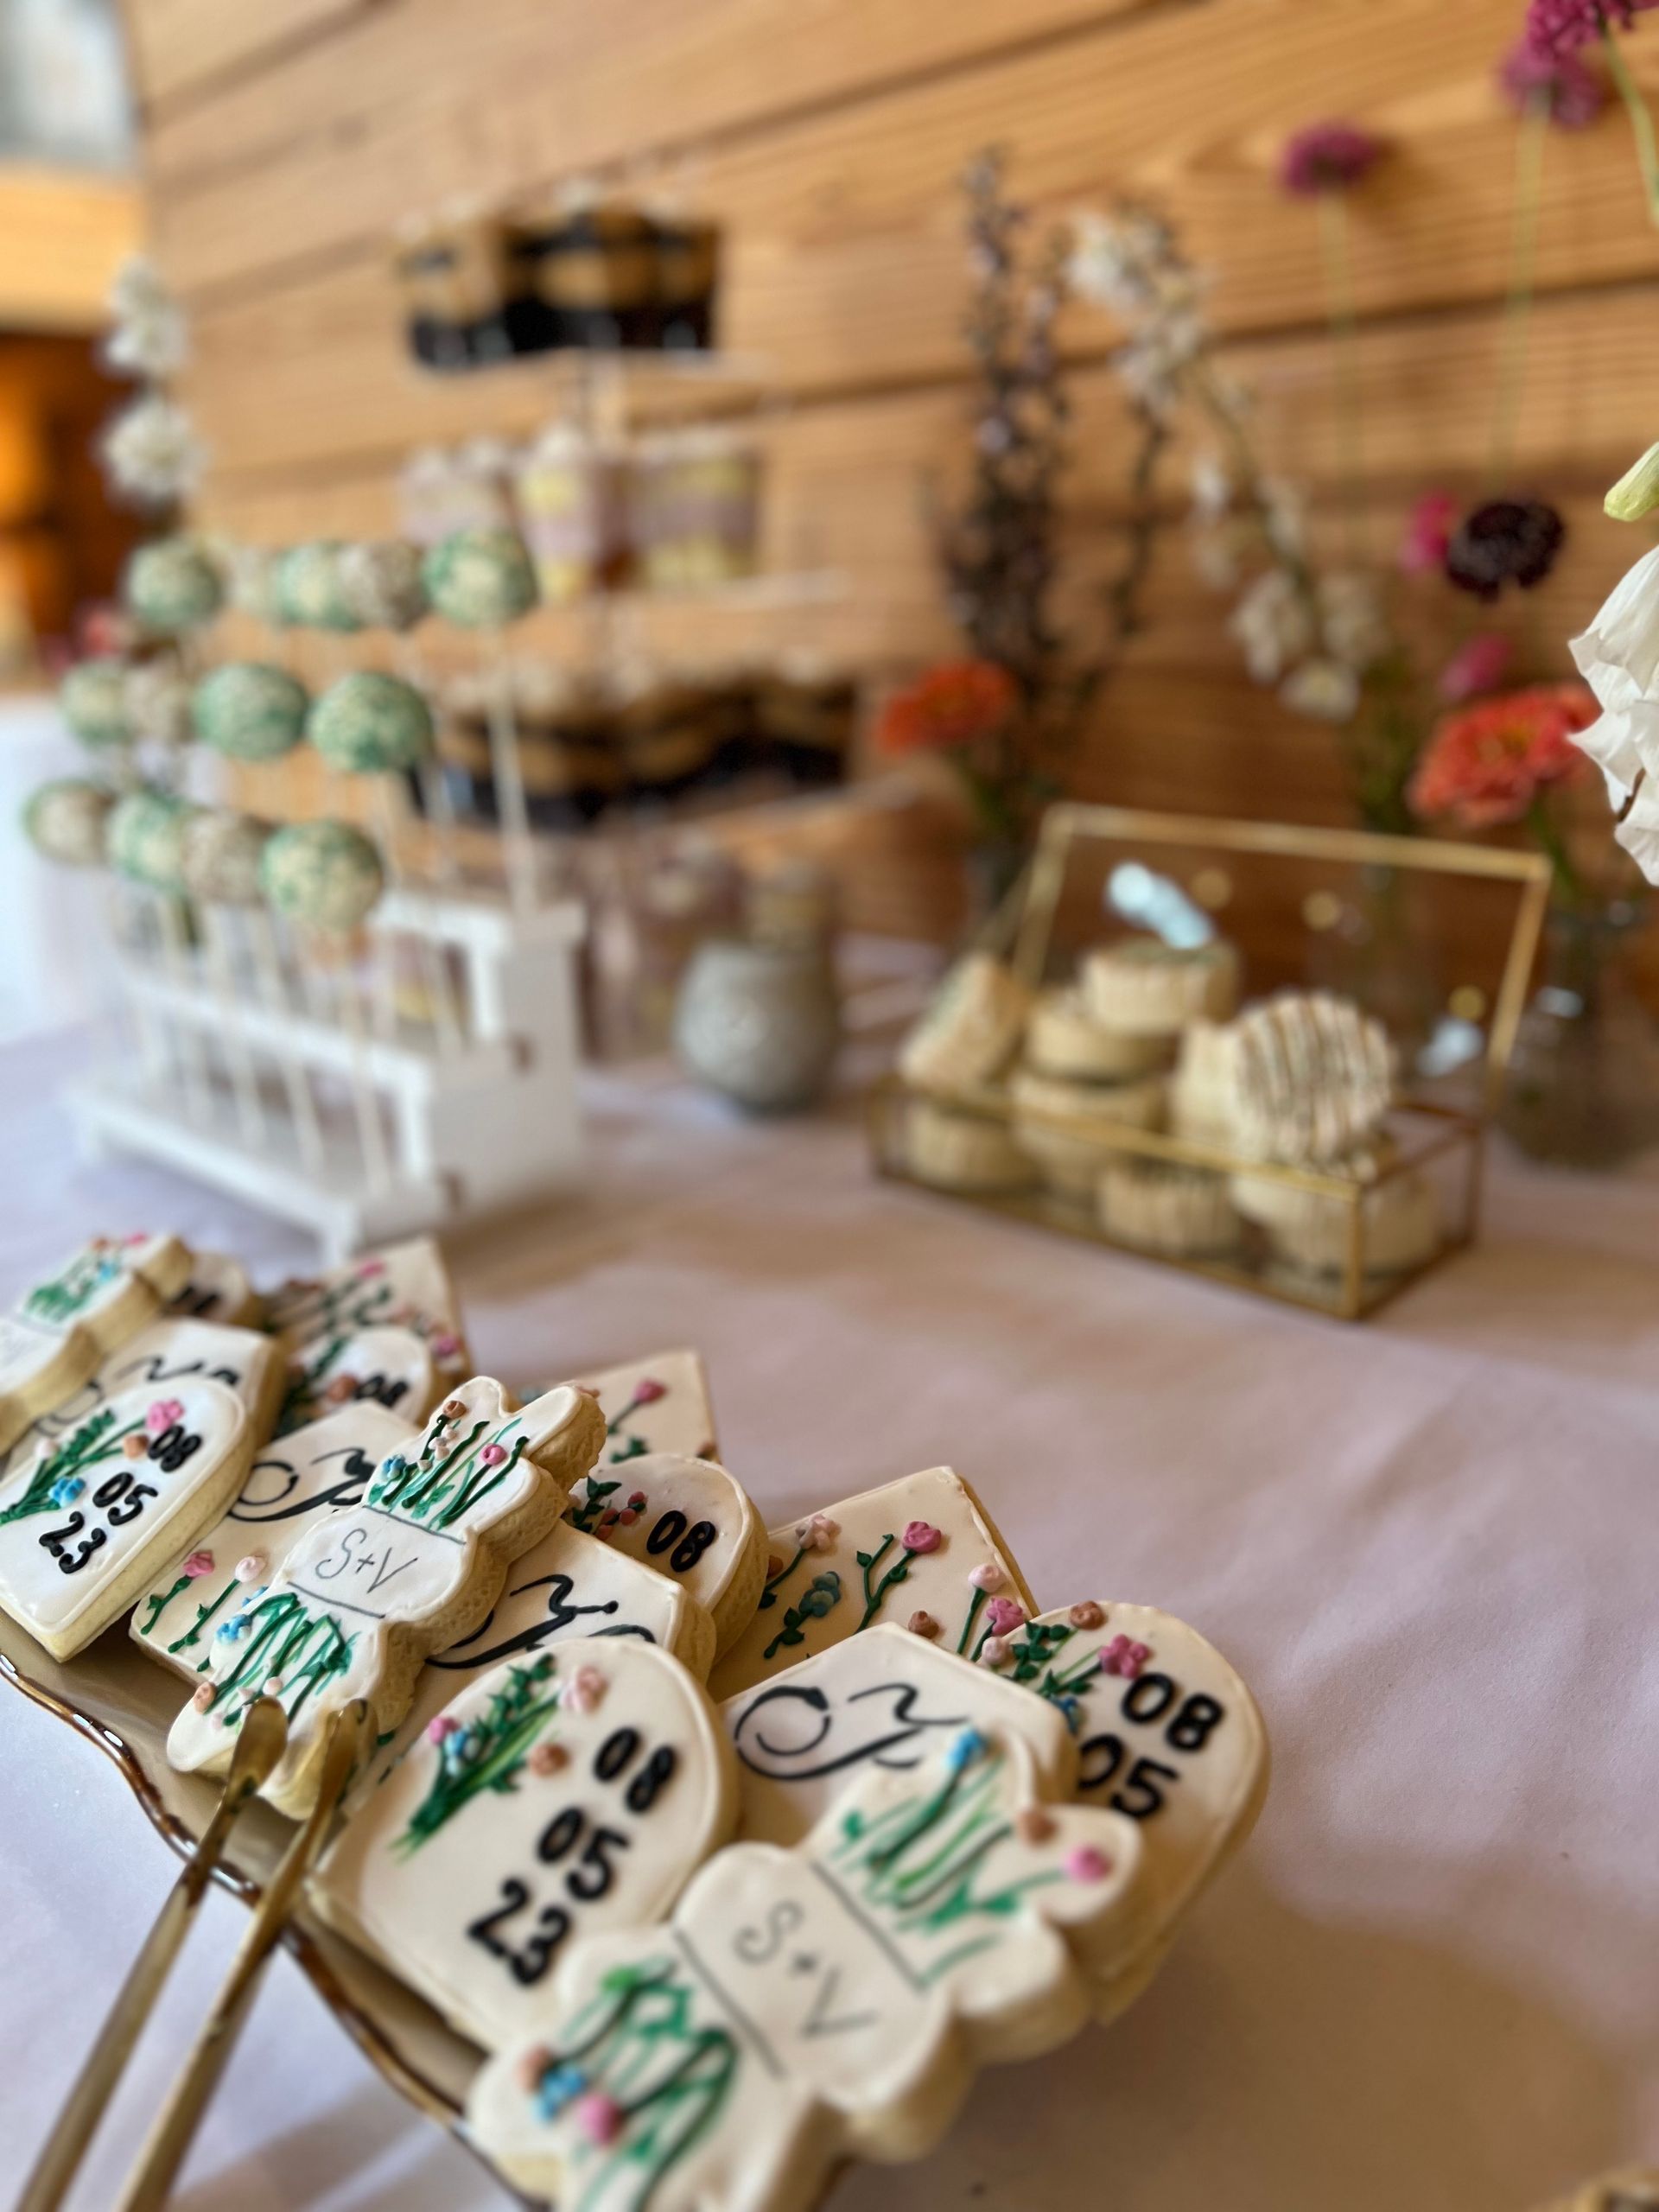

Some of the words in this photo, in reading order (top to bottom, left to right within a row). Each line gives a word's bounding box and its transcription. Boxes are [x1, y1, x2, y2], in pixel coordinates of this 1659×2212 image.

[148, 1426, 202, 1472] 08
[92, 1471, 158, 1526] 05
[39, 1511, 106, 1574] 23
[646, 1510, 716, 1573] 08
[1121, 1673, 1224, 1753] 08
[594, 1727, 676, 1814] 08
[1077, 1733, 1179, 1820] 05
[537, 1808, 630, 1901] 05
[467, 1878, 573, 1985] 23
